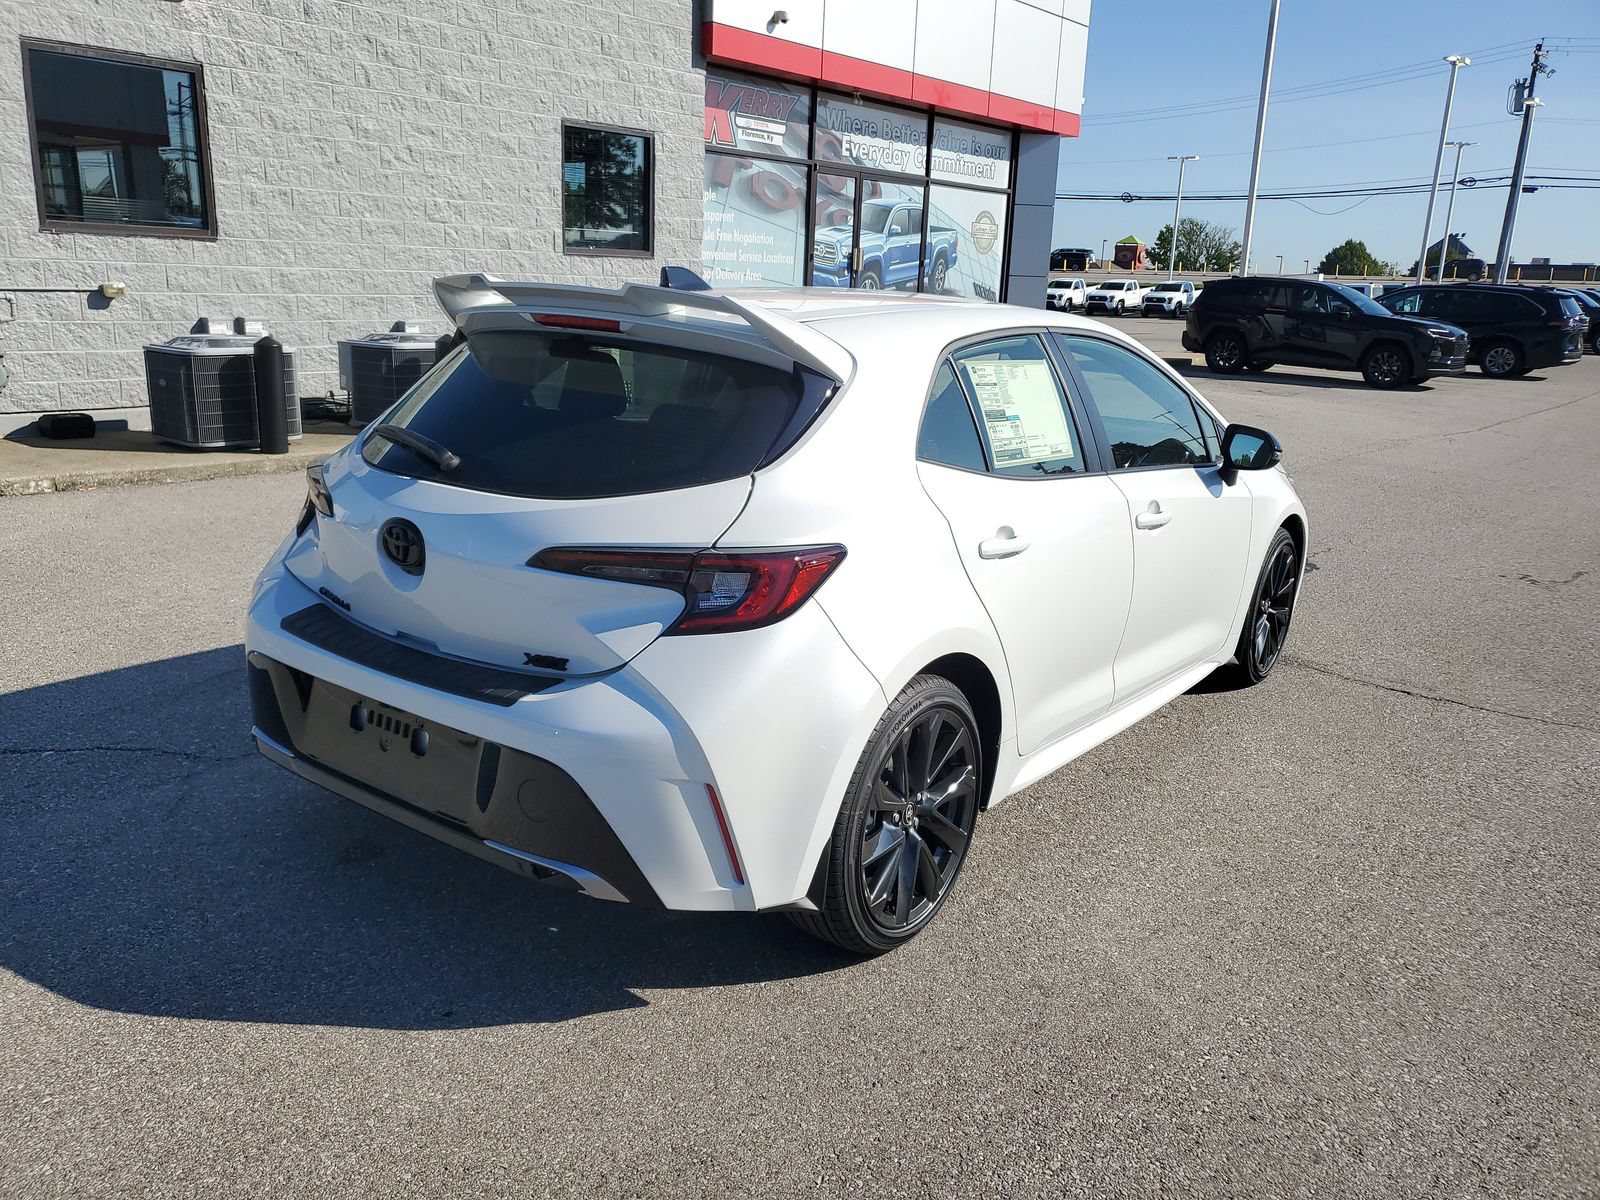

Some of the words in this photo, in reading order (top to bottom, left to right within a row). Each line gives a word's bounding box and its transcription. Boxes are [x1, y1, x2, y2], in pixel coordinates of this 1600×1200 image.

[741, 129, 766, 142] Florence,
[766, 134, 774, 142] Ky
[825, 106, 878, 139] Where
[882, 118, 928, 146] Better
[971, 135, 982, 157] is
[984, 143, 1007, 161] our
[841, 134, 911, 171] Everyday
[703, 187, 716, 203] ple
[716, 229, 733, 242] Free
[734, 229, 774, 247] Negotiation
[738, 249, 762, 264] Service
[763, 250, 793, 265] Locations
[715, 267, 744, 284] Delivery
[745, 268, 761, 281] Area
[890, 700, 923, 734] YOKOHAMA
